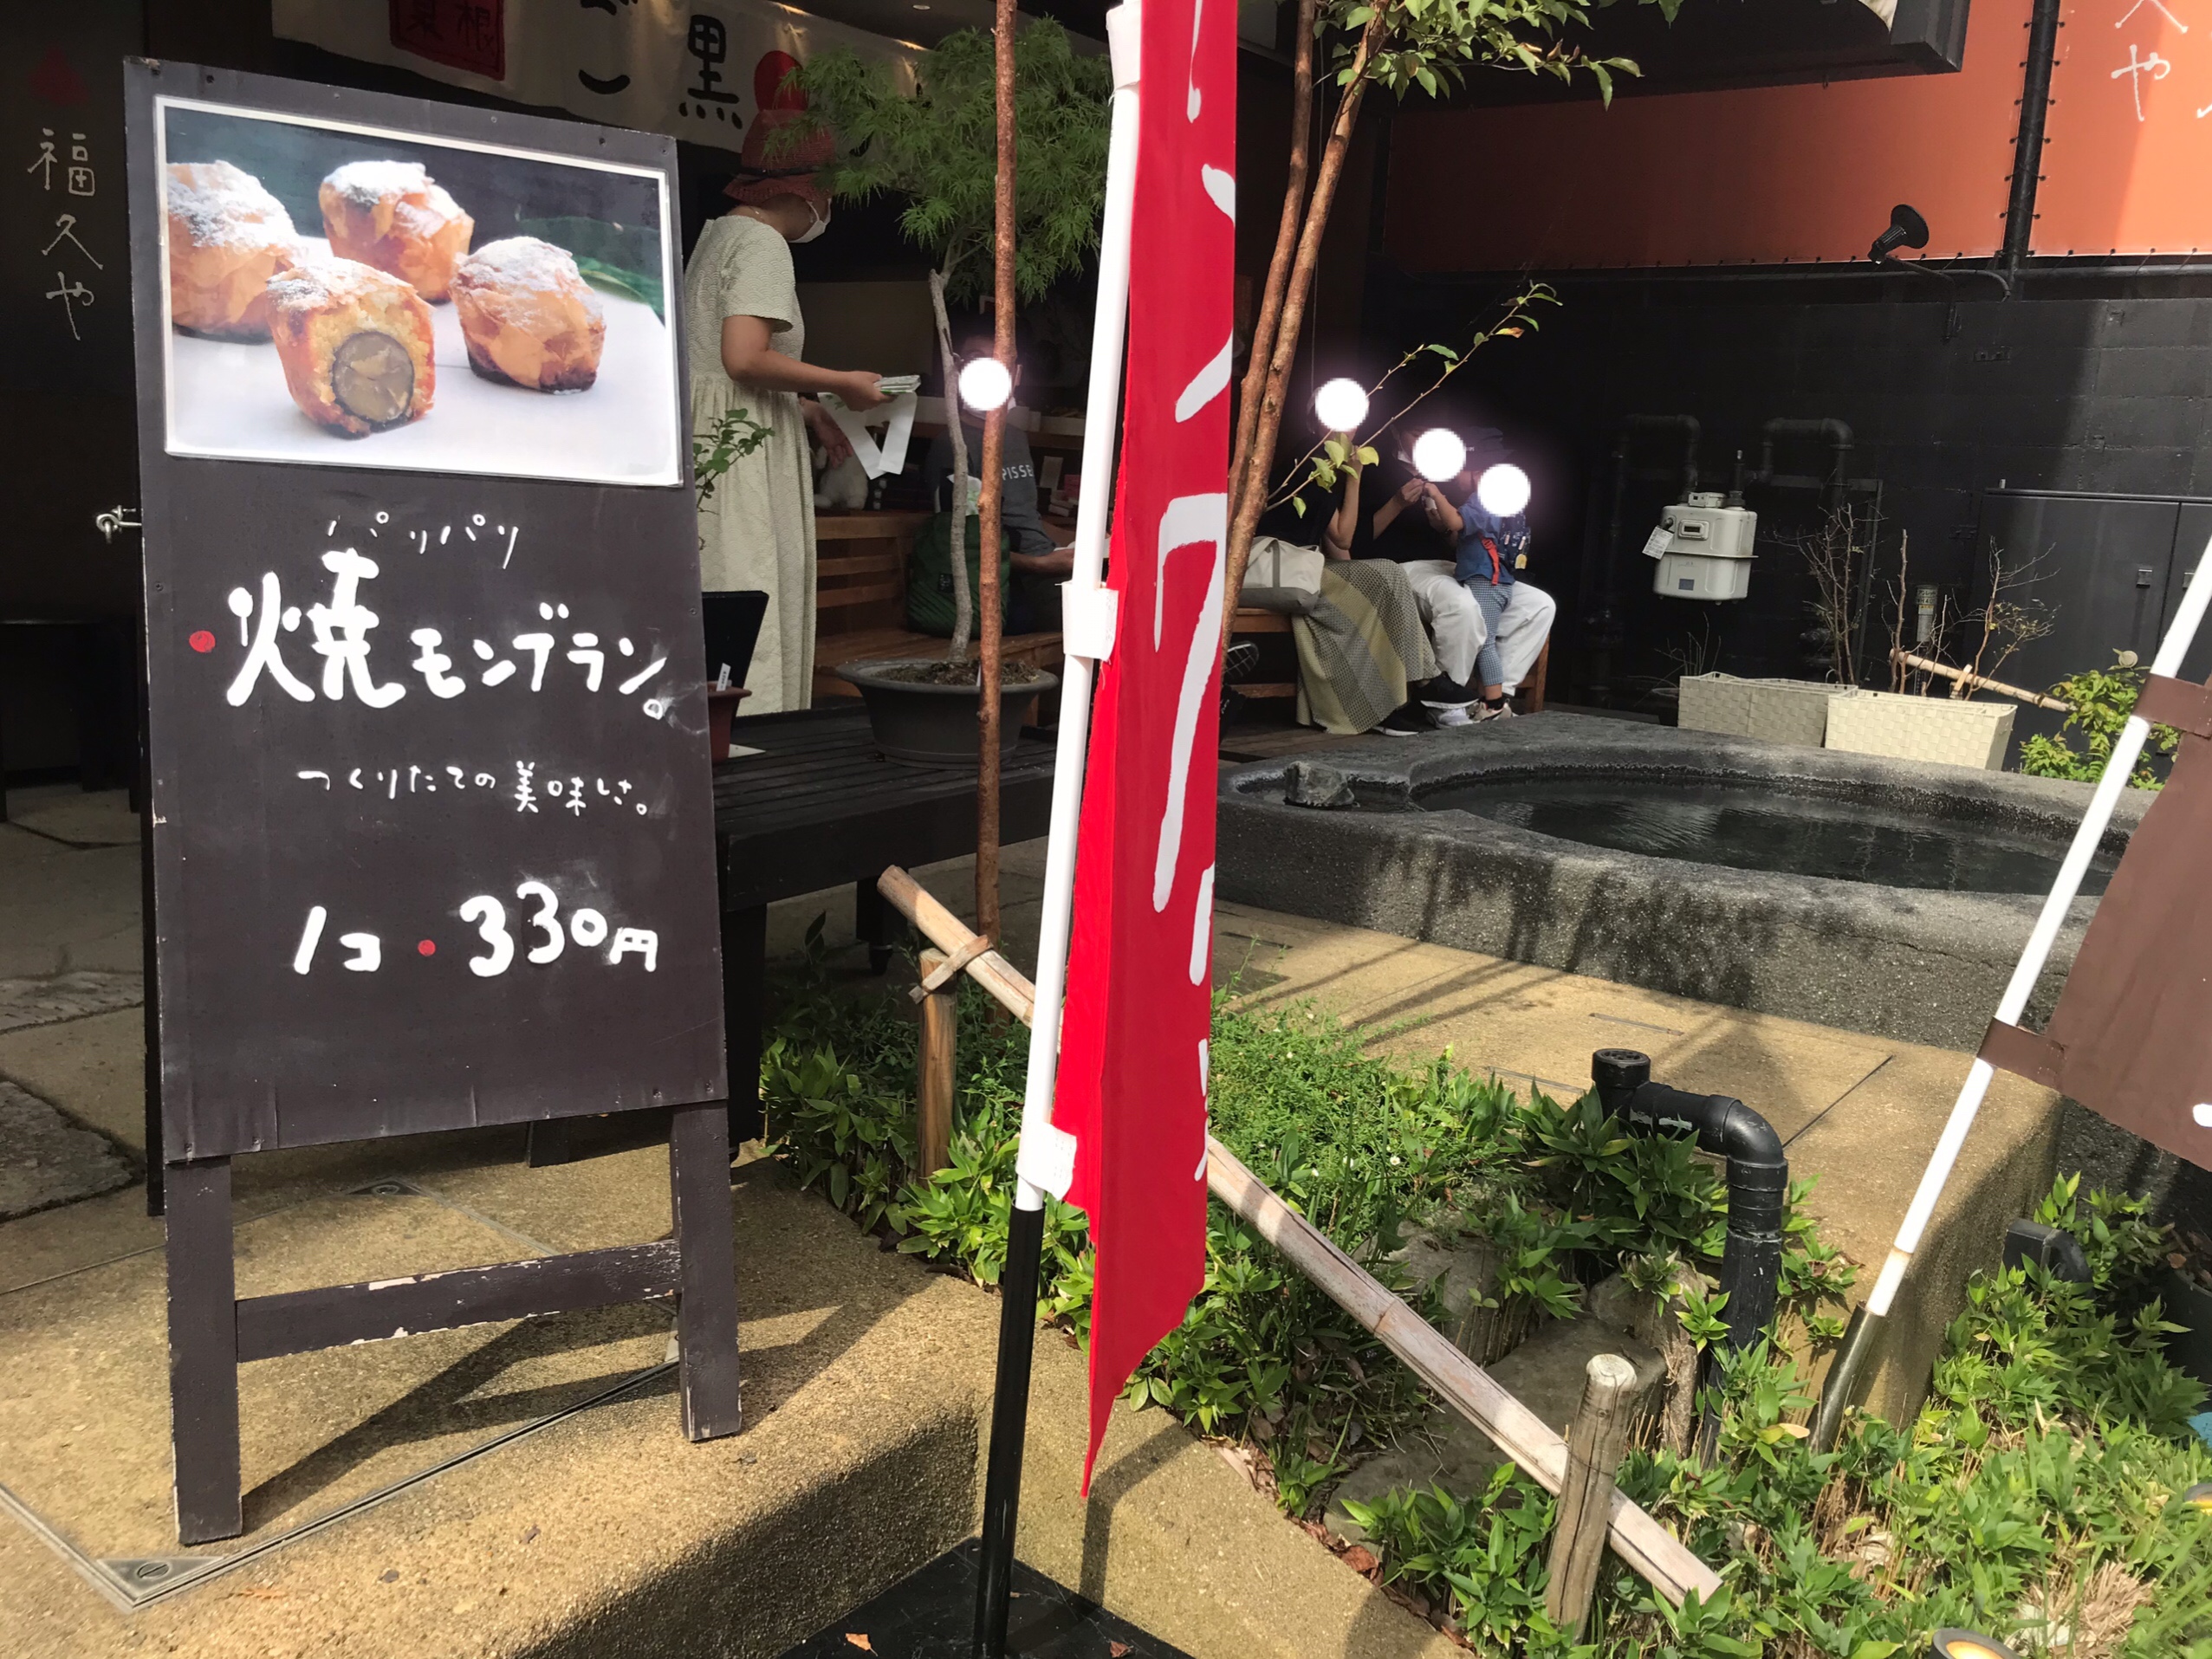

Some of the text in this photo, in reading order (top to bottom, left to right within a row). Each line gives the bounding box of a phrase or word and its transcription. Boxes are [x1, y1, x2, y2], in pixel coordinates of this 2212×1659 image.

[678, 13, 745, 131] 黒
[27, 127, 104, 341] 福久や
[459, 880, 658, 977] 330円
